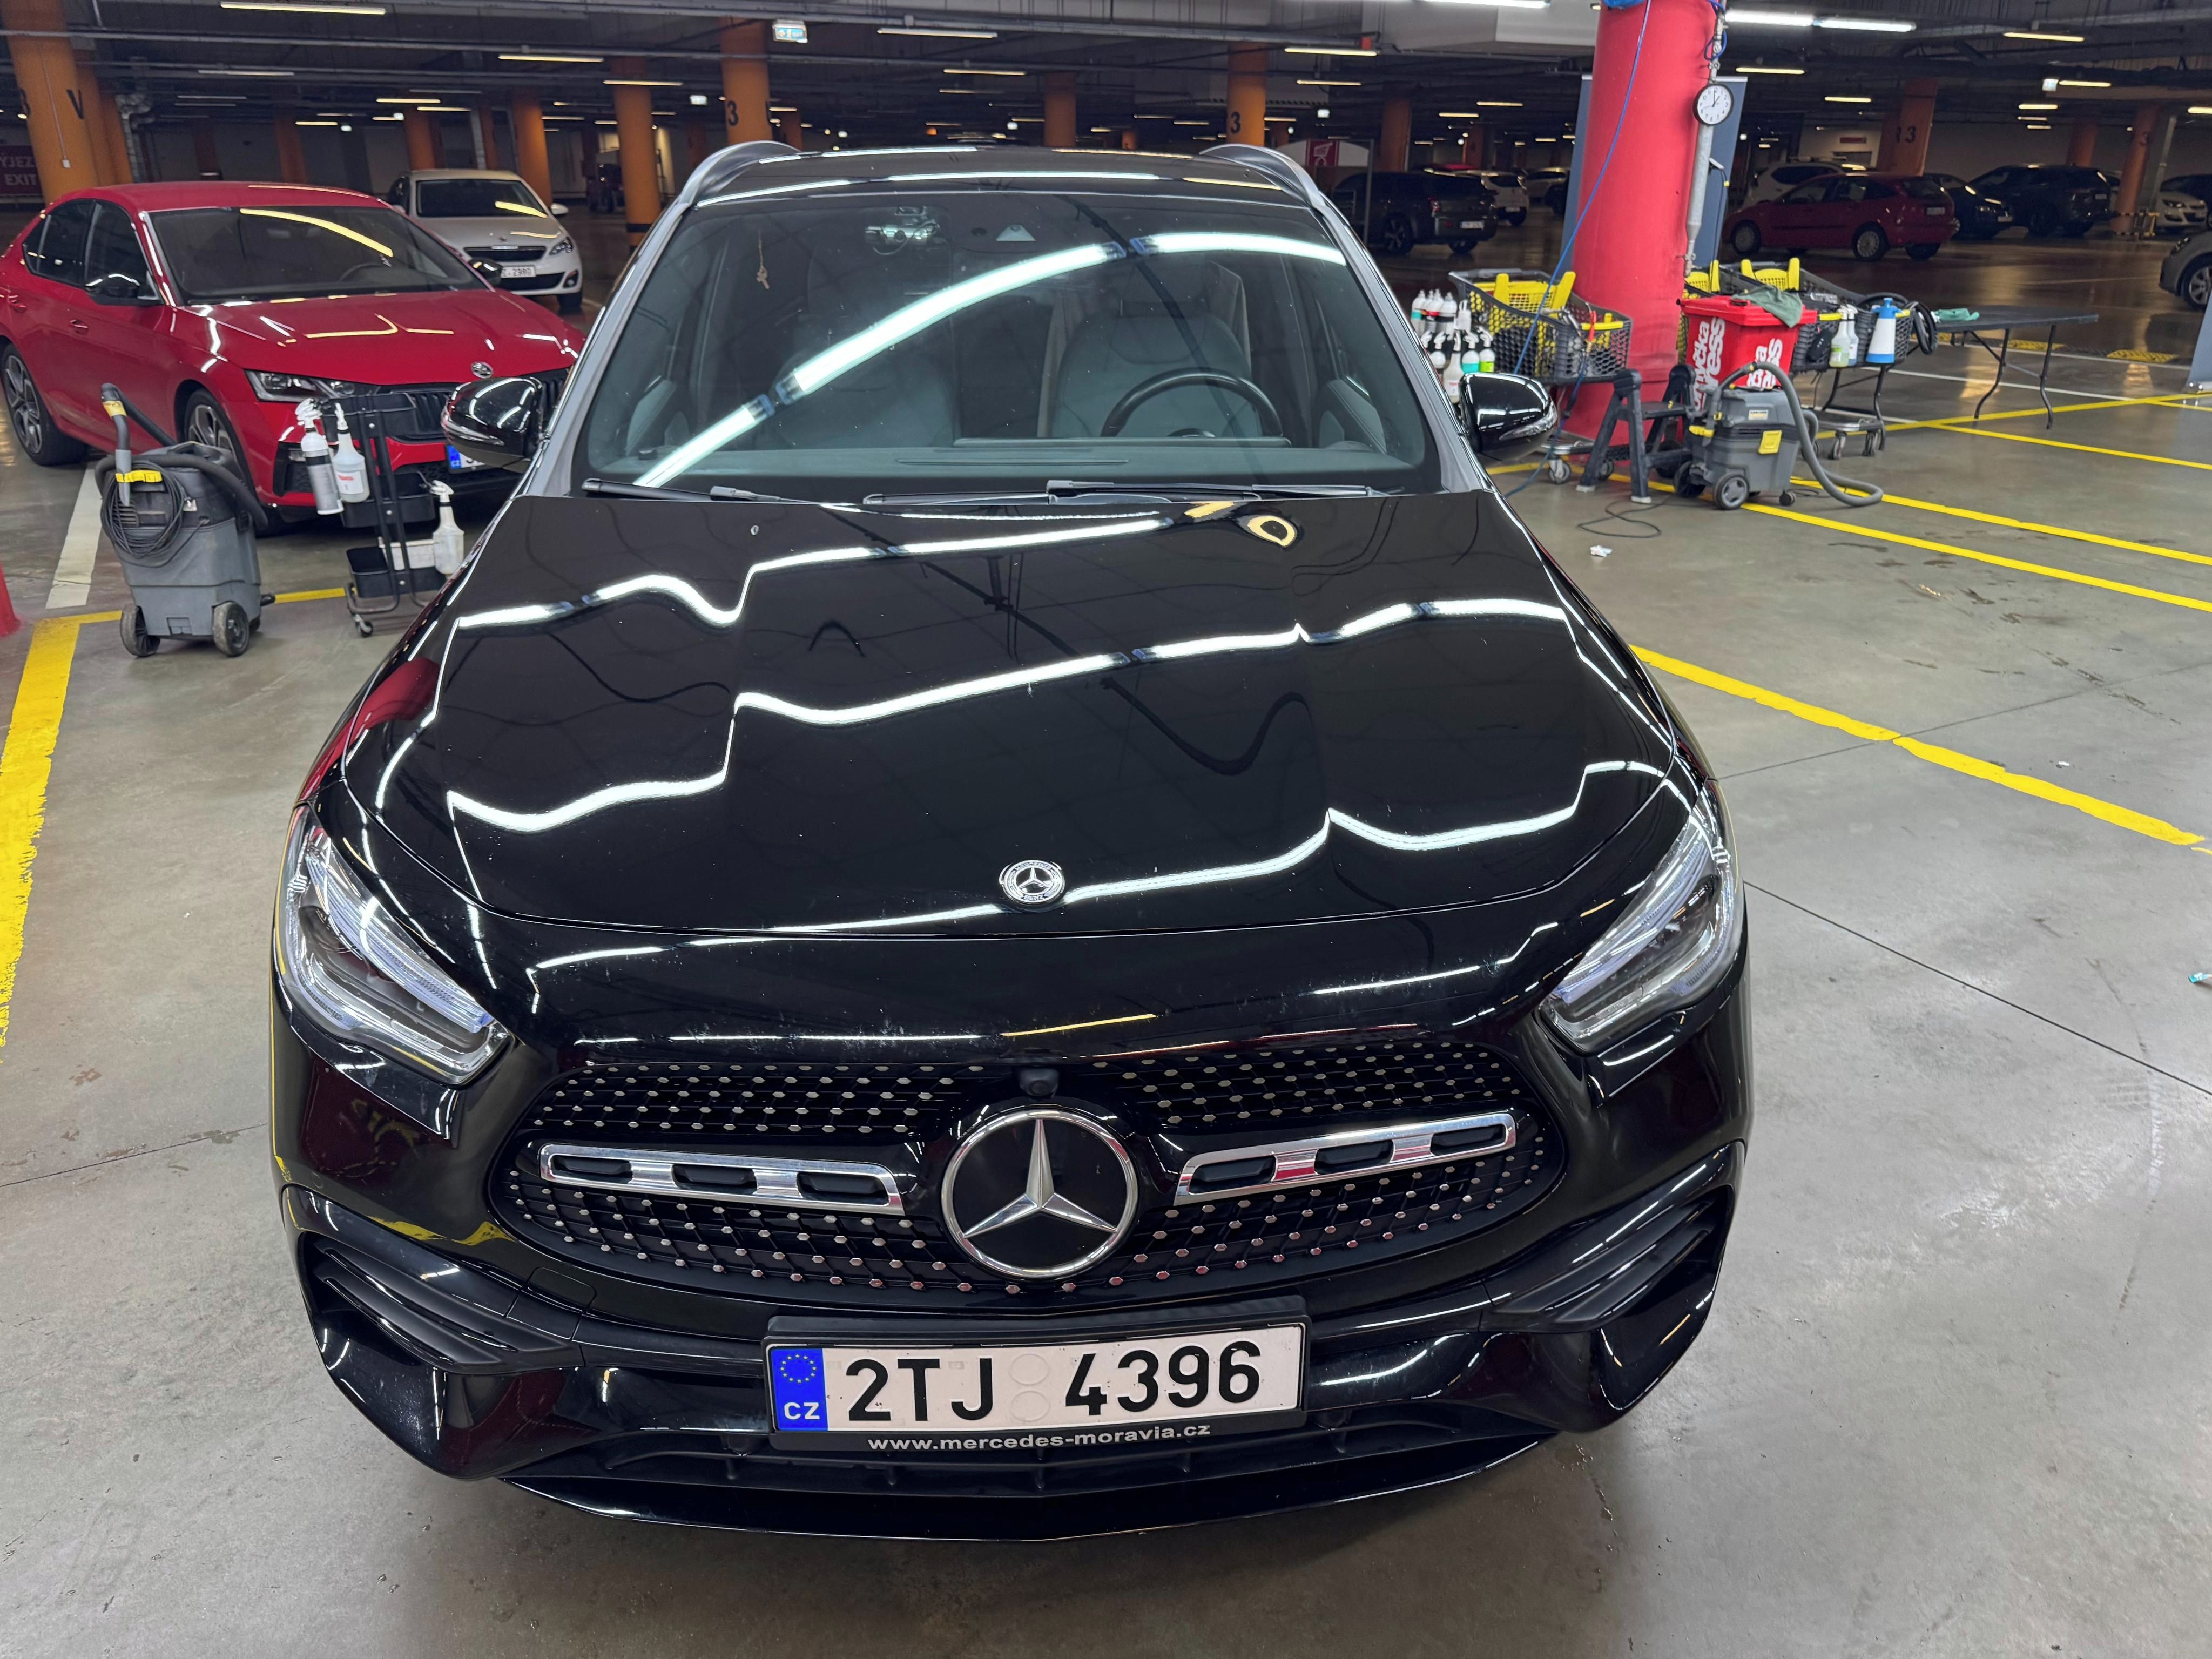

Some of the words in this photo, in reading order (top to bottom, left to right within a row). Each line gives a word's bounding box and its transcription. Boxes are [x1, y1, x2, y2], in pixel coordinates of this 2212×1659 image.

[727, 100, 739, 126] 3
[1231, 112, 1240, 134] 3
[4, 173, 37, 186] EXIT
[846, 1357, 993, 1422] 2TJ
[1065, 1340, 1262, 1416] 4396
[783, 1401, 820, 1420] CZ
[867, 1424, 1211, 1451] www.mercedes-moravia.cz
